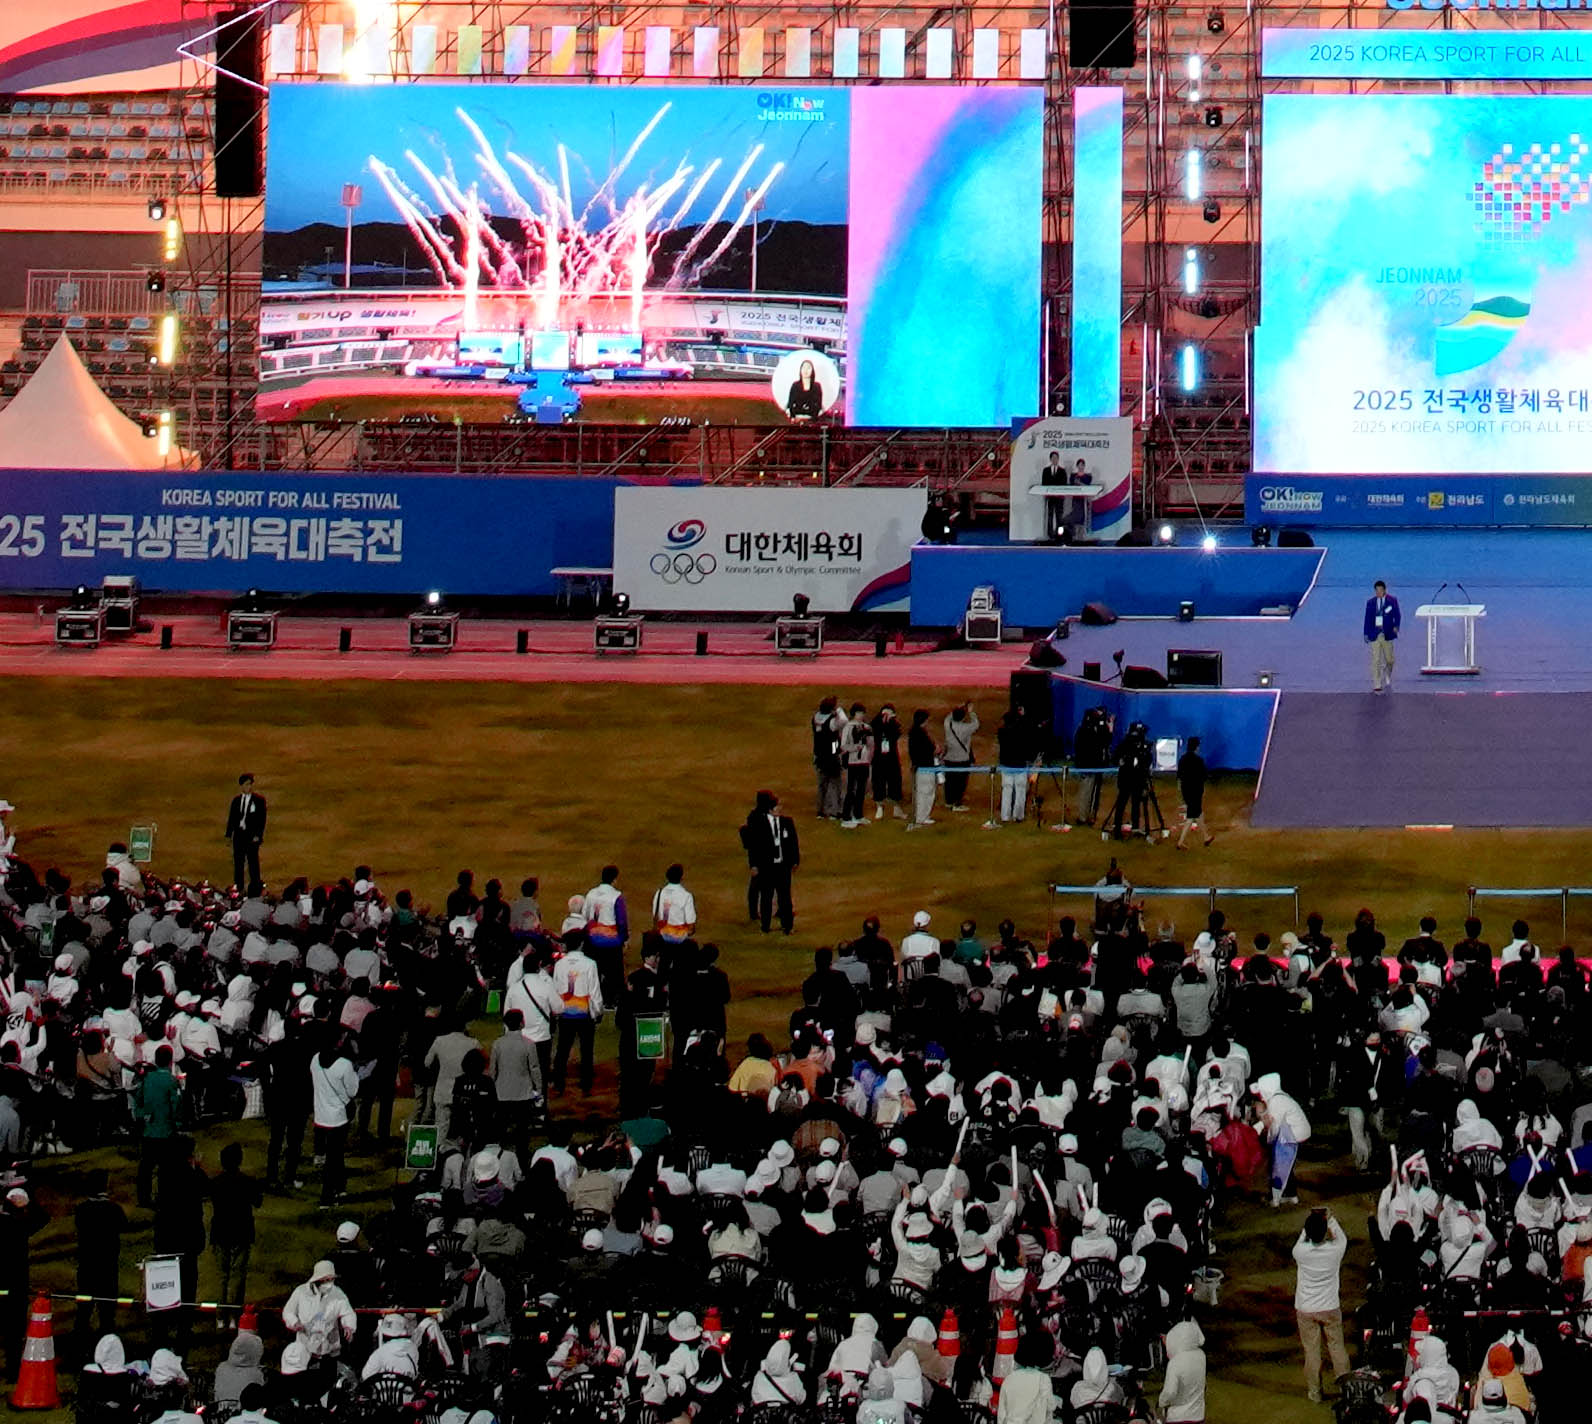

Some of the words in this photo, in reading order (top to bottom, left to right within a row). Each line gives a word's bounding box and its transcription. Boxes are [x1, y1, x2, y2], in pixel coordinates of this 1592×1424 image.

[1309, 44, 1354, 63] 2025
[1361, 44, 1427, 63] KOREA
[1434, 44, 1499, 63] SPORT
[1506, 44, 1544, 63] FOR
[1551, 44, 1584, 63] ALL
[757, 109, 824, 122] Jeonnam
[1375, 266, 1462, 285] JEONNAM
[1415, 288, 1462, 308] 2025
[1353, 390, 1413, 411] 2025
[1391, 420, 1441, 433] KOREA
[1446, 420, 1494, 433] SPORT
[161, 489, 212, 506] KOREA
[215, 490, 263, 506] SPORT
[268, 491, 297, 508] FOR
[302, 492, 329, 509] ALL
[333, 493, 401, 510] FESTIVAL
[59, 514, 403, 563] 전국생활체육대축전
[725, 531, 862, 562] 대한체육회
[725, 565, 751, 574] Korean
[753, 565, 774, 575] Sport
[786, 565, 816, 575] Olympic
[819, 565, 861, 574] Committee
